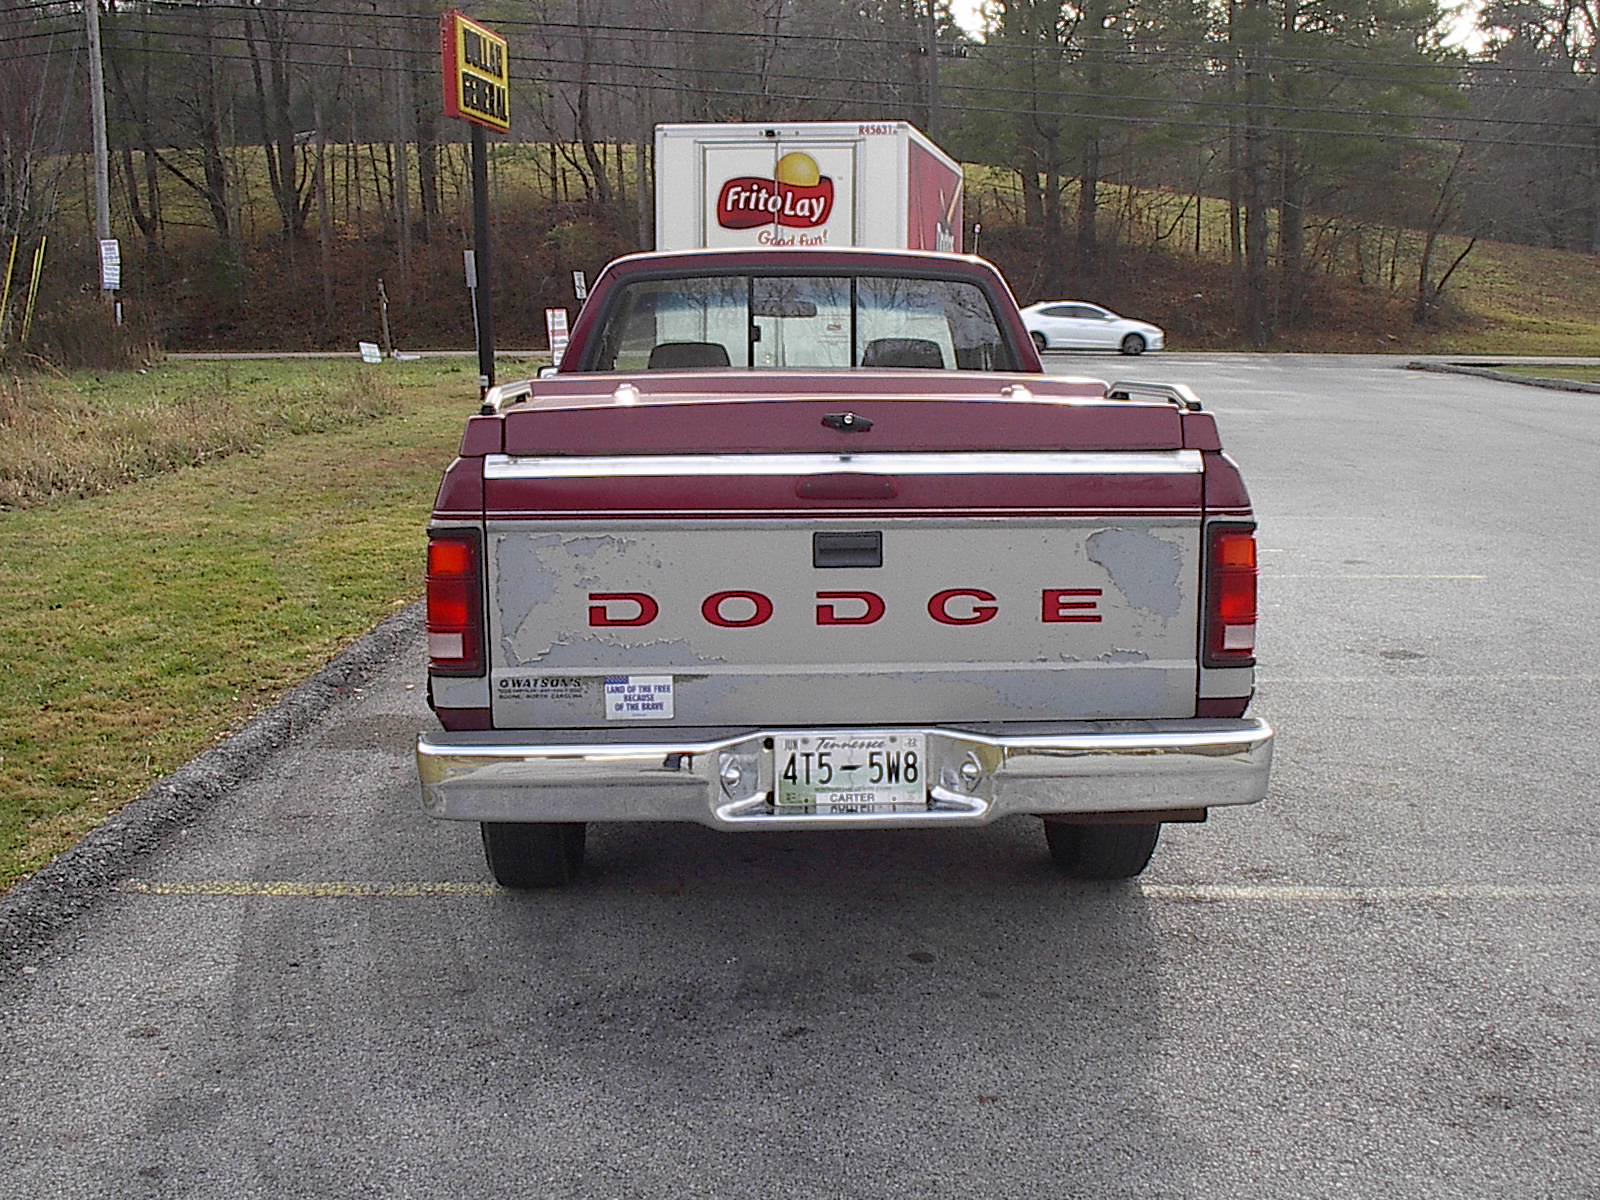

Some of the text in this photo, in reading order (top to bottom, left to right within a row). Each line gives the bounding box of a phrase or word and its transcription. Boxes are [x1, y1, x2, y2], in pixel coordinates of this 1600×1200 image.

[463, 28, 503, 79] DOLLAR
[462, 72, 508, 122] GENERAL
[758, 229, 829, 247] Good fun!
[588, 588, 1103, 628] DODGE
[606, 684, 671, 694] LAND OF THE FREE
[624, 694, 655, 702] BECAUSE
[614, 702, 665, 711] OF THE BRAVE
[815, 737, 886, 751] Tennessee
[829, 792, 875, 802] CARTER
